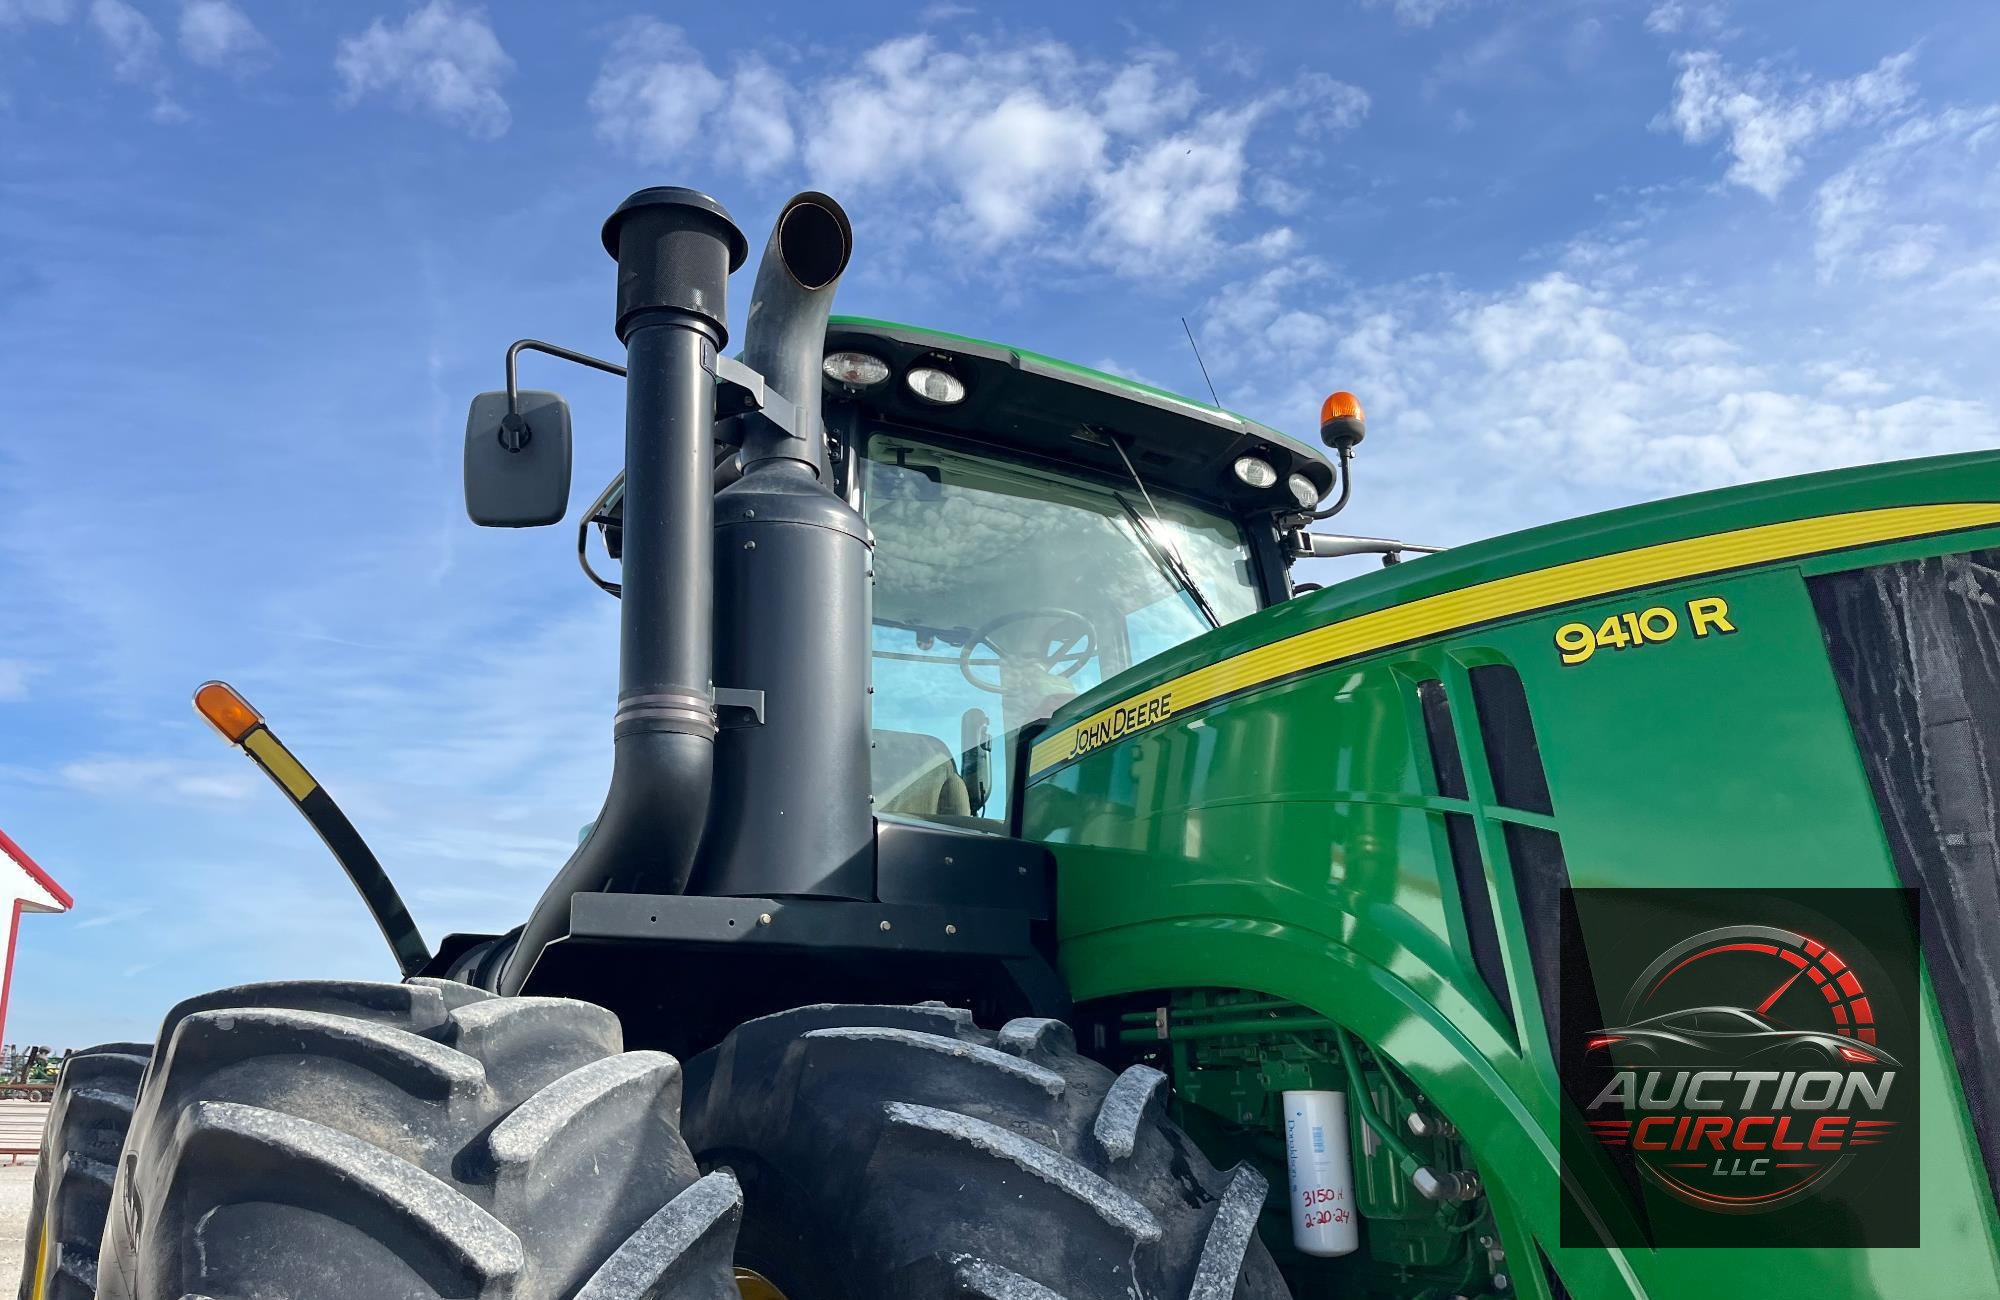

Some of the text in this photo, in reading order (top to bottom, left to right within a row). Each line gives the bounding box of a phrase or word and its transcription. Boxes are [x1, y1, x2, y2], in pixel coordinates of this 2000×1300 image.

[1554, 596, 1738, 667] 9410 R
[1070, 693, 1172, 757] JOHN DEERE
[1287, 1119, 1298, 1179] Donaldson
[1302, 1188, 1334, 1207] 3150
